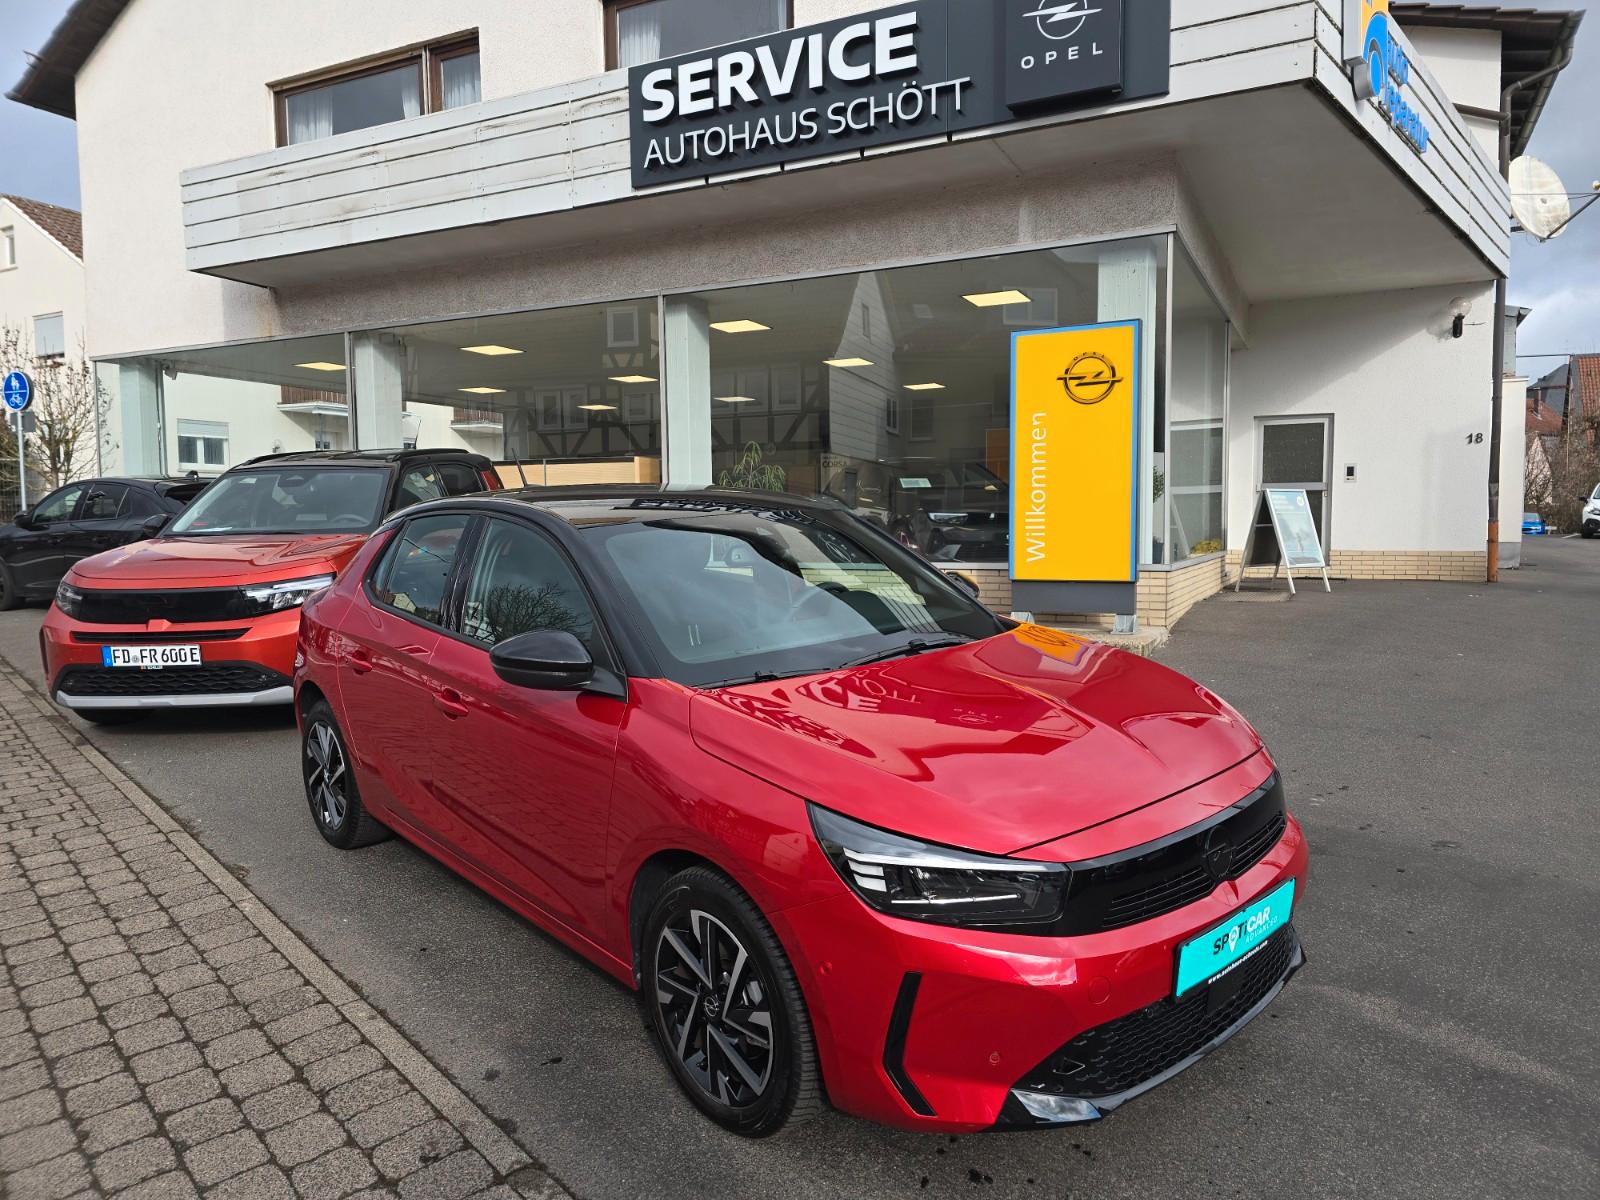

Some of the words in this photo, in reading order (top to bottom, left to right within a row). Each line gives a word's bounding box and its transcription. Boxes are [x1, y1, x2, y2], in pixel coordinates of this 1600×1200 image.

[641, 12, 918, 122] SERVICE
[1021, 42, 1103, 69] OPEL
[643, 107, 817, 168] AUTOHAUS
[828, 76, 970, 134] SCHÖTT
[1465, 432, 1483, 445] 18
[1025, 412, 1047, 563] Willkommen
[113, 648, 130, 664] FD
